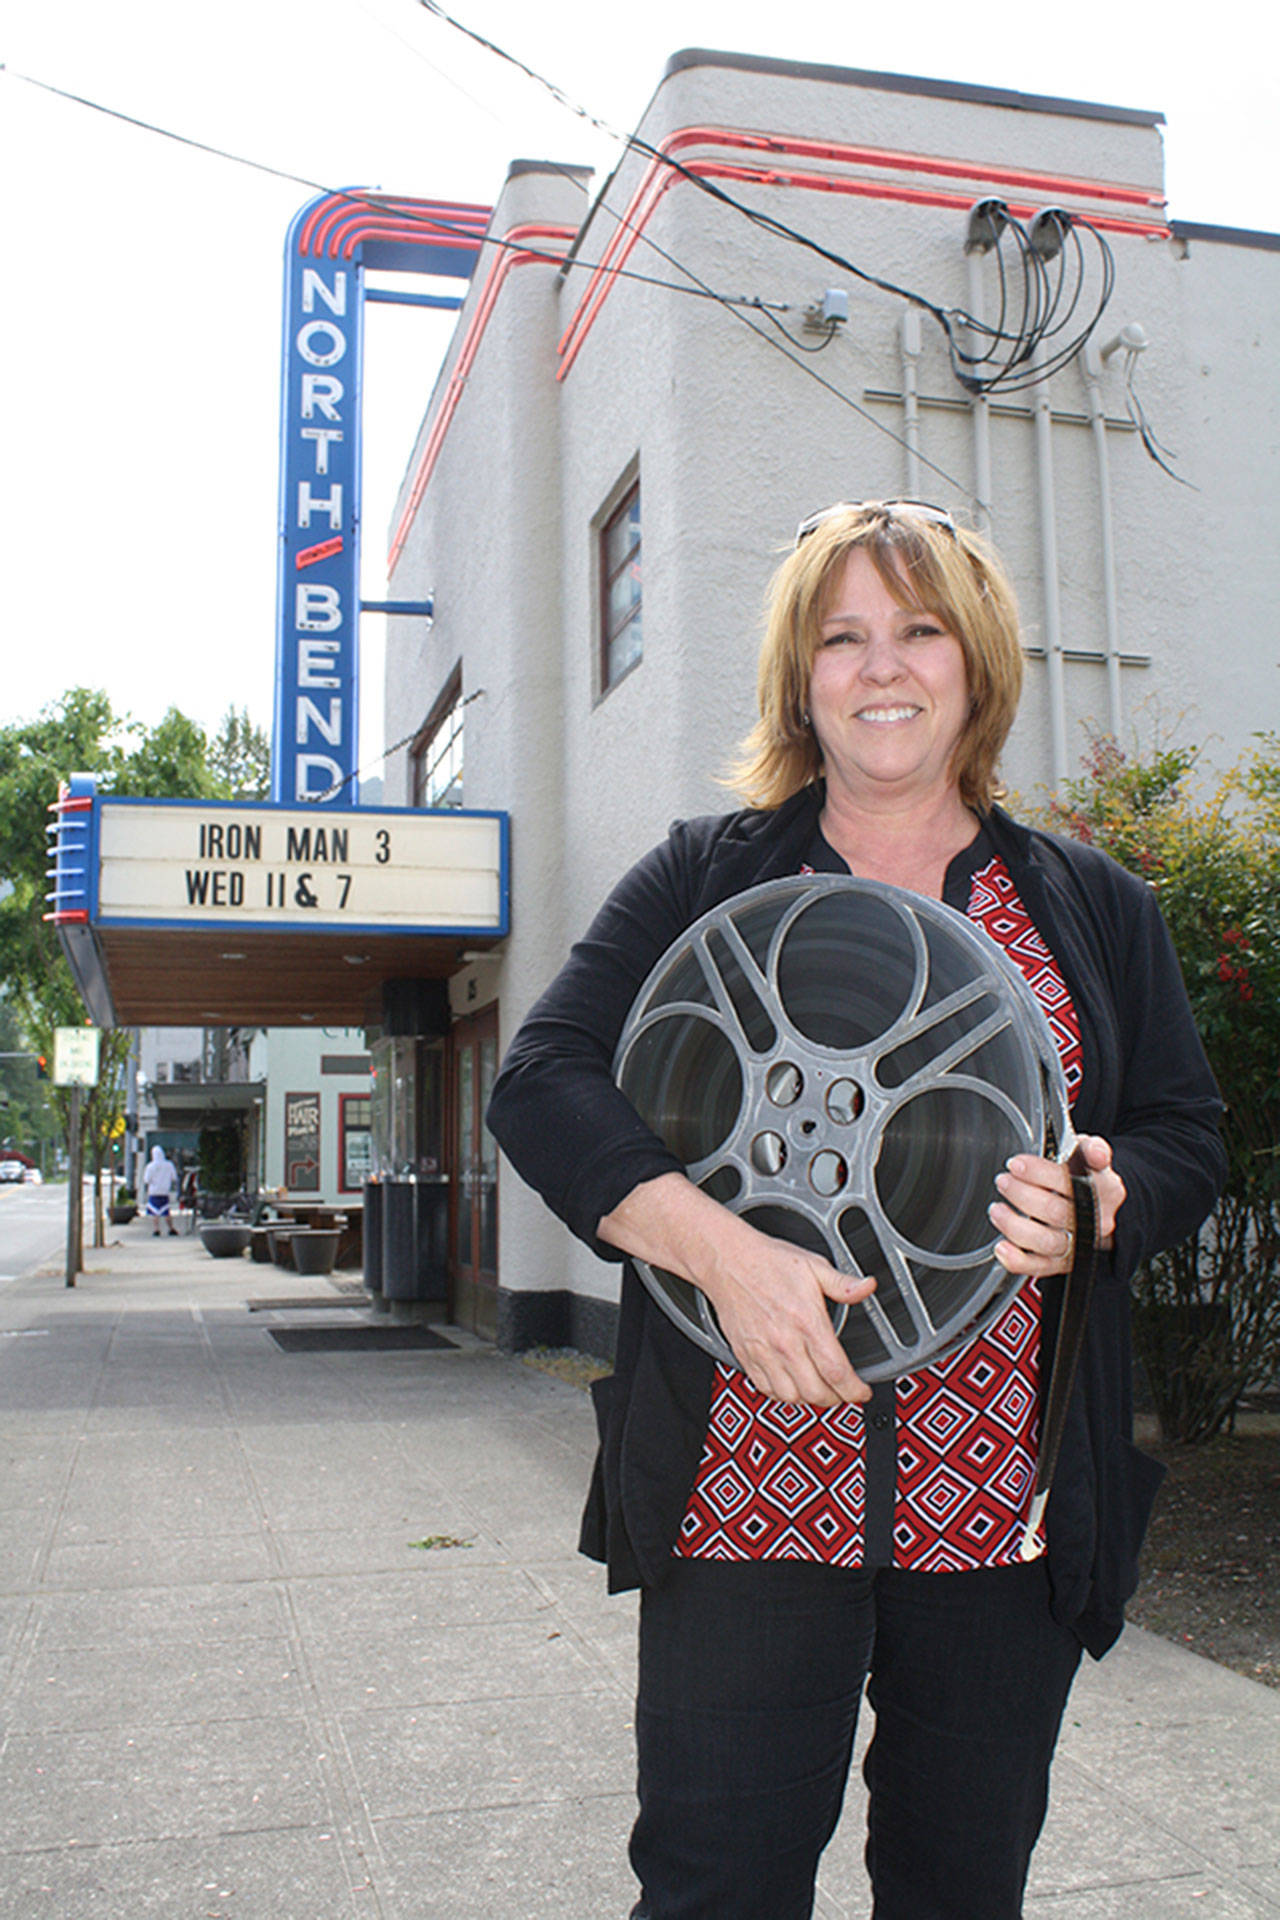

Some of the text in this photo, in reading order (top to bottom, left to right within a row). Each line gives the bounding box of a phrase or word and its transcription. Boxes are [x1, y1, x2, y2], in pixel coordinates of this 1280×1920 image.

[296, 268, 347, 530] NORTH
[295, 583, 344, 803] BEND
[186, 870, 245, 907] WED
[337, 874, 352, 909] 7
[200, 823, 391, 863] IRON MAN 3
